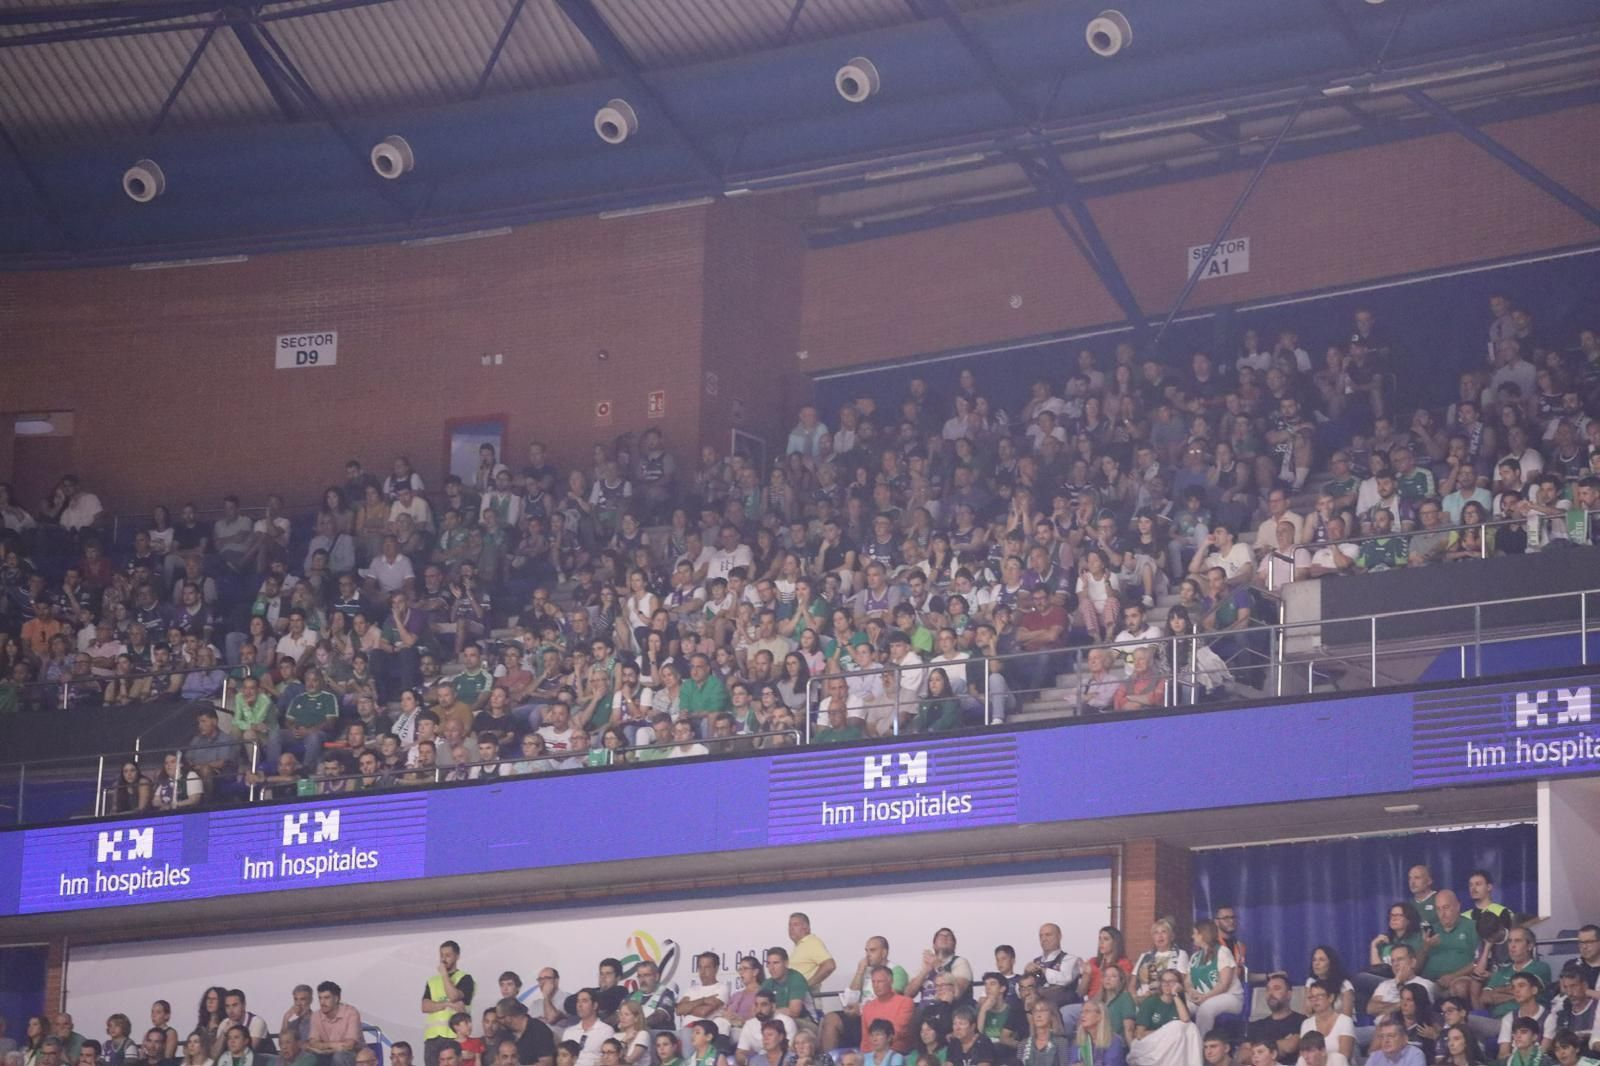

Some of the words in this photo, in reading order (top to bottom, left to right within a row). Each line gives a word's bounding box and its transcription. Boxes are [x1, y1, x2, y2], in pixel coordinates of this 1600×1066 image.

[1207, 258, 1229, 276] A1
[280, 334, 333, 349] SECTOR
[296, 350, 319, 365] D9
[1467, 741, 1506, 768] hm
[822, 801, 854, 826] hm
[863, 790, 972, 825] hospitales
[243, 856, 274, 880] hm
[281, 846, 379, 879] hospitales
[59, 873, 89, 896] hm
[95, 863, 191, 895] hospitales
